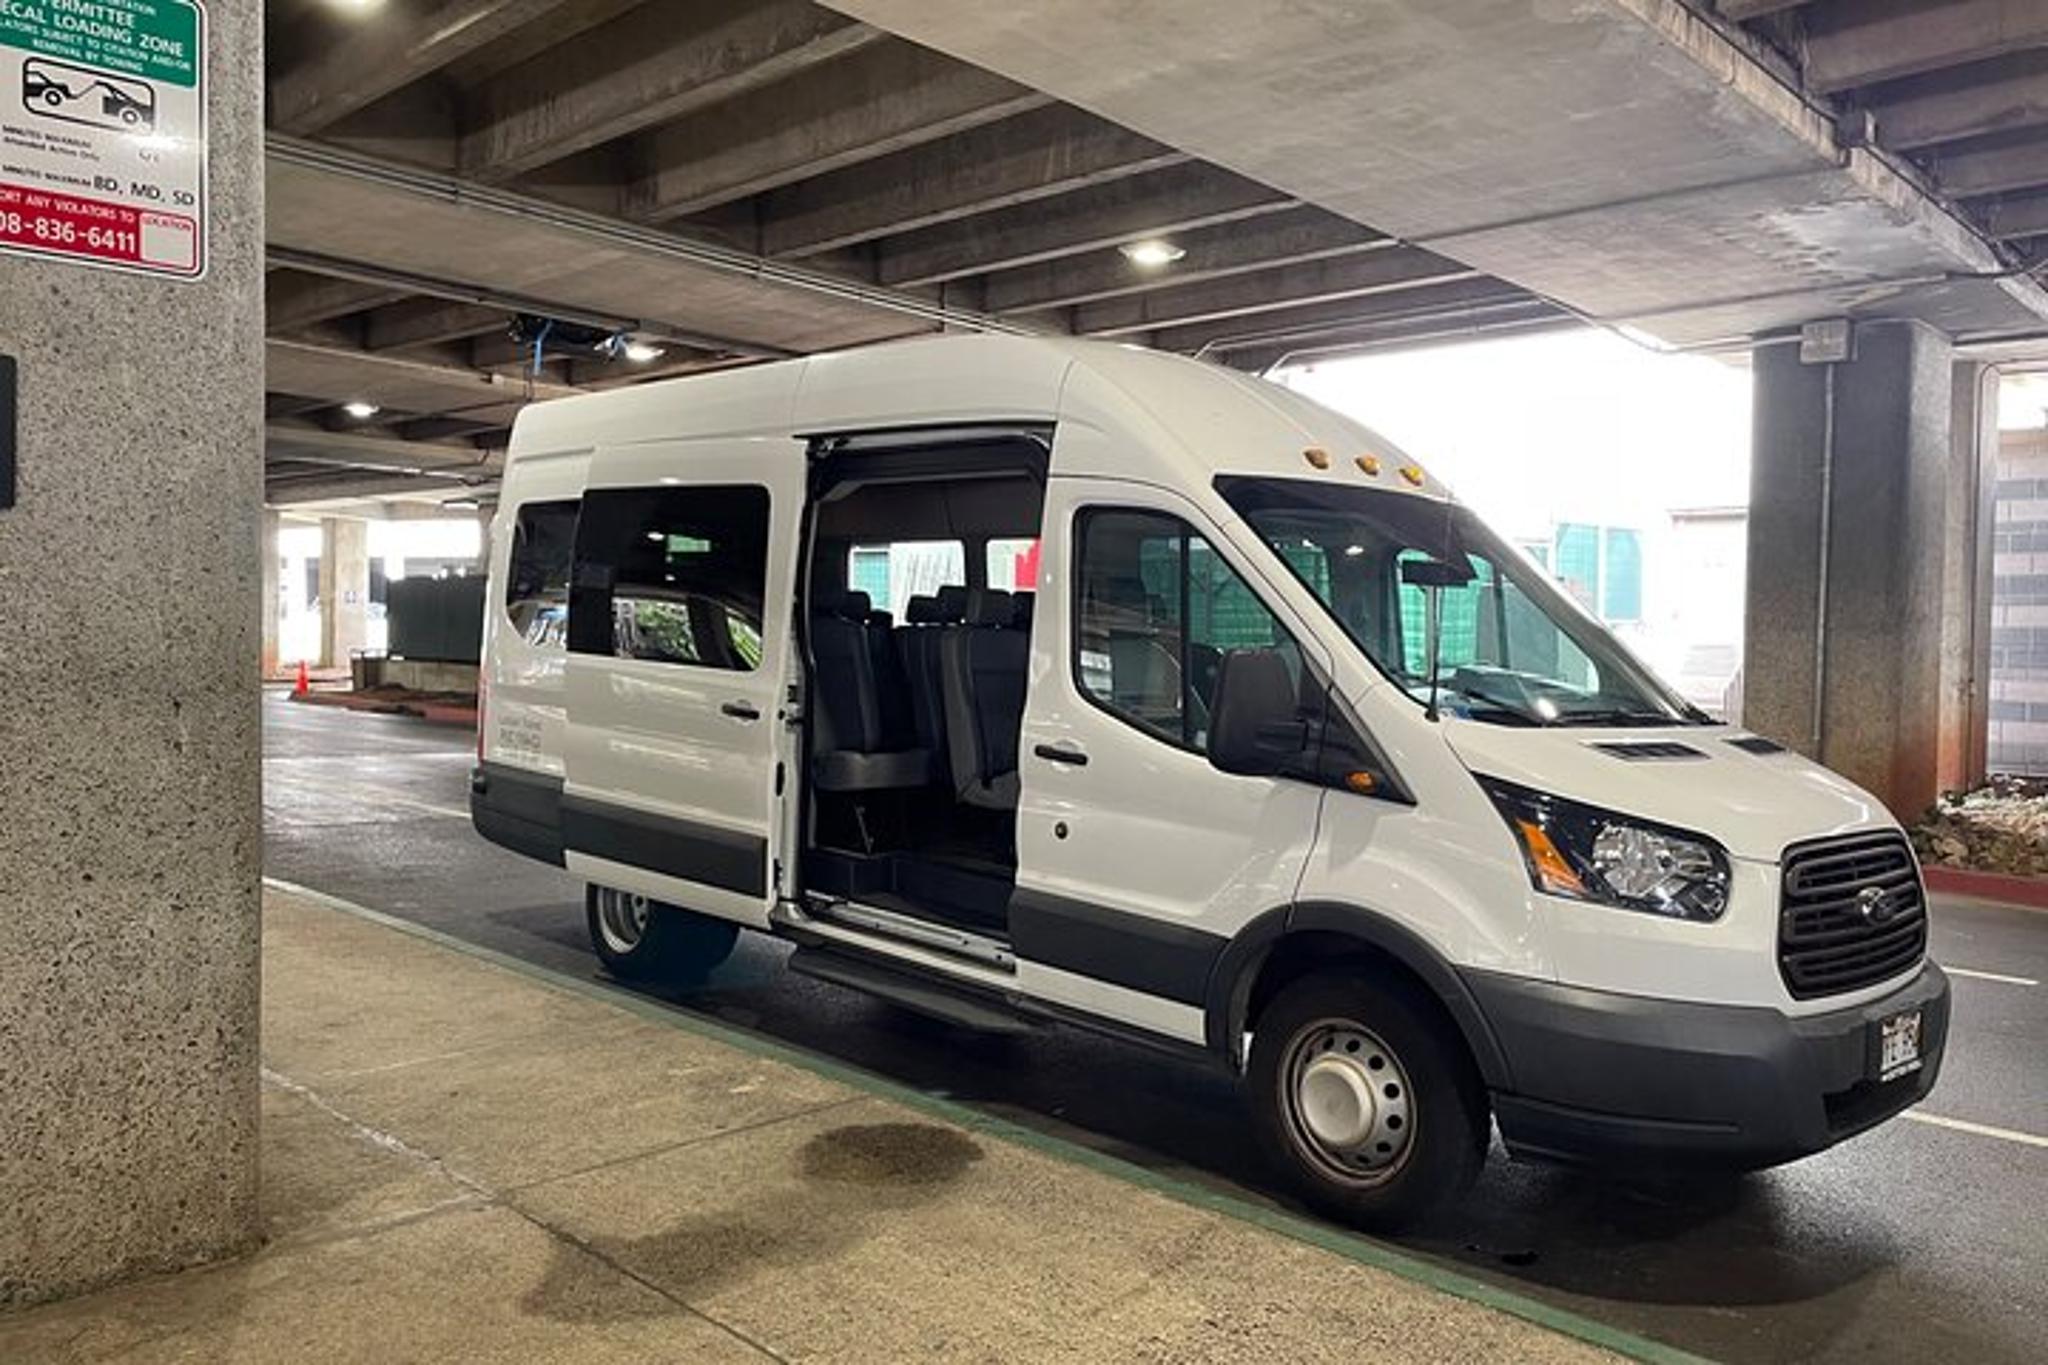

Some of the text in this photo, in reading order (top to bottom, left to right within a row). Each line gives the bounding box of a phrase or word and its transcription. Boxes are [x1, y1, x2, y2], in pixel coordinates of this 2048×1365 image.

[53, 13, 132, 43] LOADING
[139, 33, 183, 57] ZONE
[86, 36, 100, 49] TO
[102, 42, 149, 61] CITATION
[32, 38, 143, 72] REMOVAL BY TOWING
[25, 193, 51, 209] ANY
[53, 198, 117, 221] VIOLATORS
[119, 209, 136, 224] TO
[173, 189, 195, 206] SD
[0, 210, 136, 254] 08-836-6411
